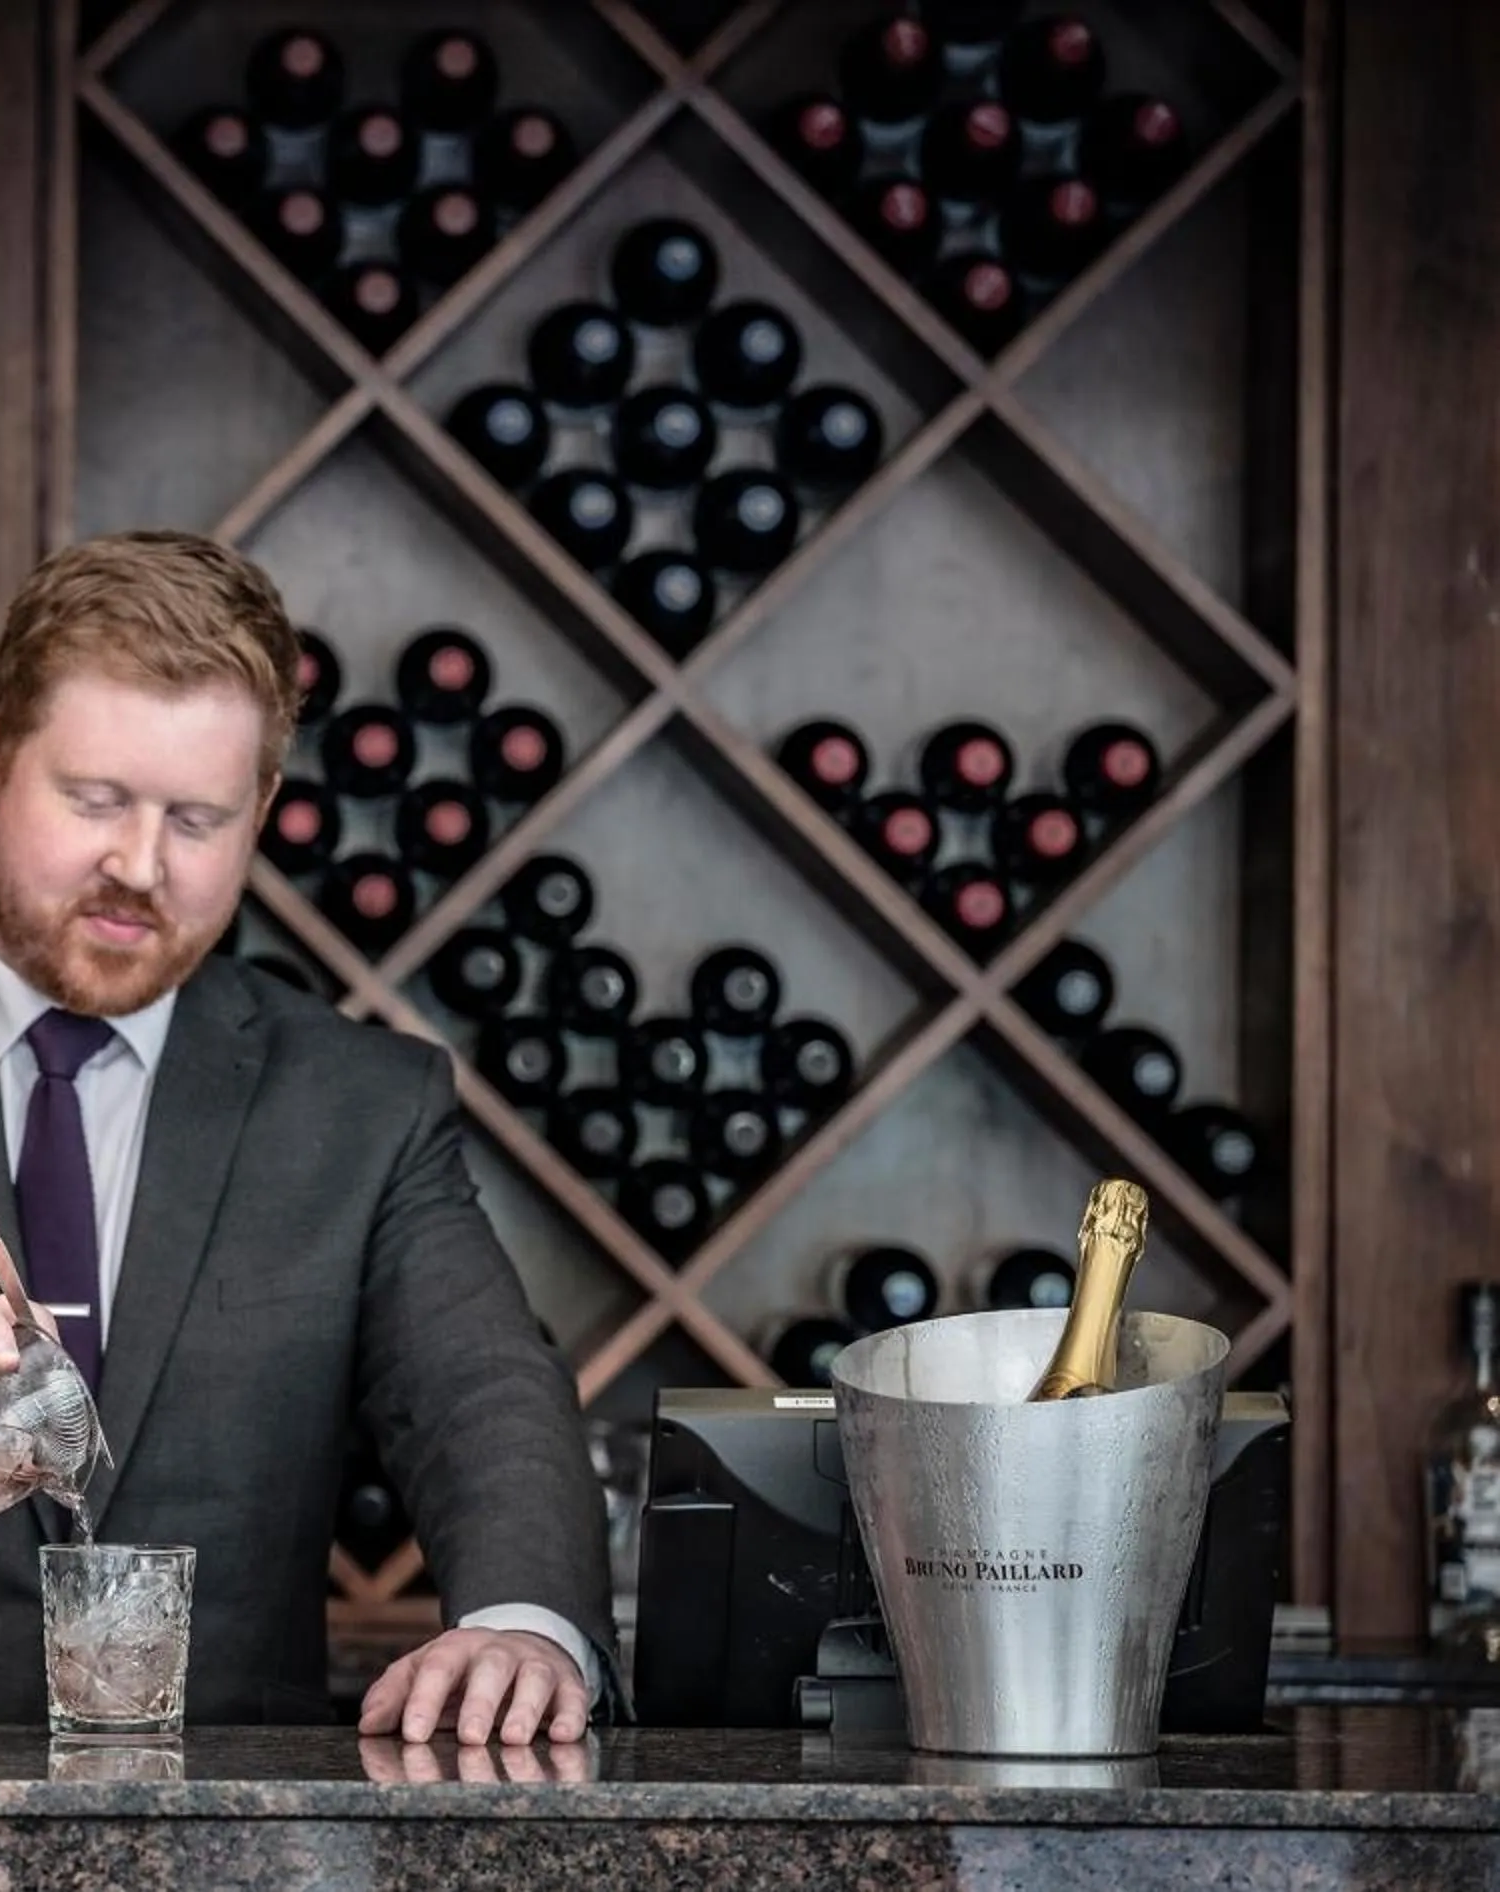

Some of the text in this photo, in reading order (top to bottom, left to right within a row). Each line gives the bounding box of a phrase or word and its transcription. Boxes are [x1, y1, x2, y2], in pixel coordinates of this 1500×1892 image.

[927, 1547, 1048, 1560] CHAMPAGNE
[904, 1556, 1083, 1580] BRUNO PAILLARD
[990, 1583, 1037, 1593] FRANCE
